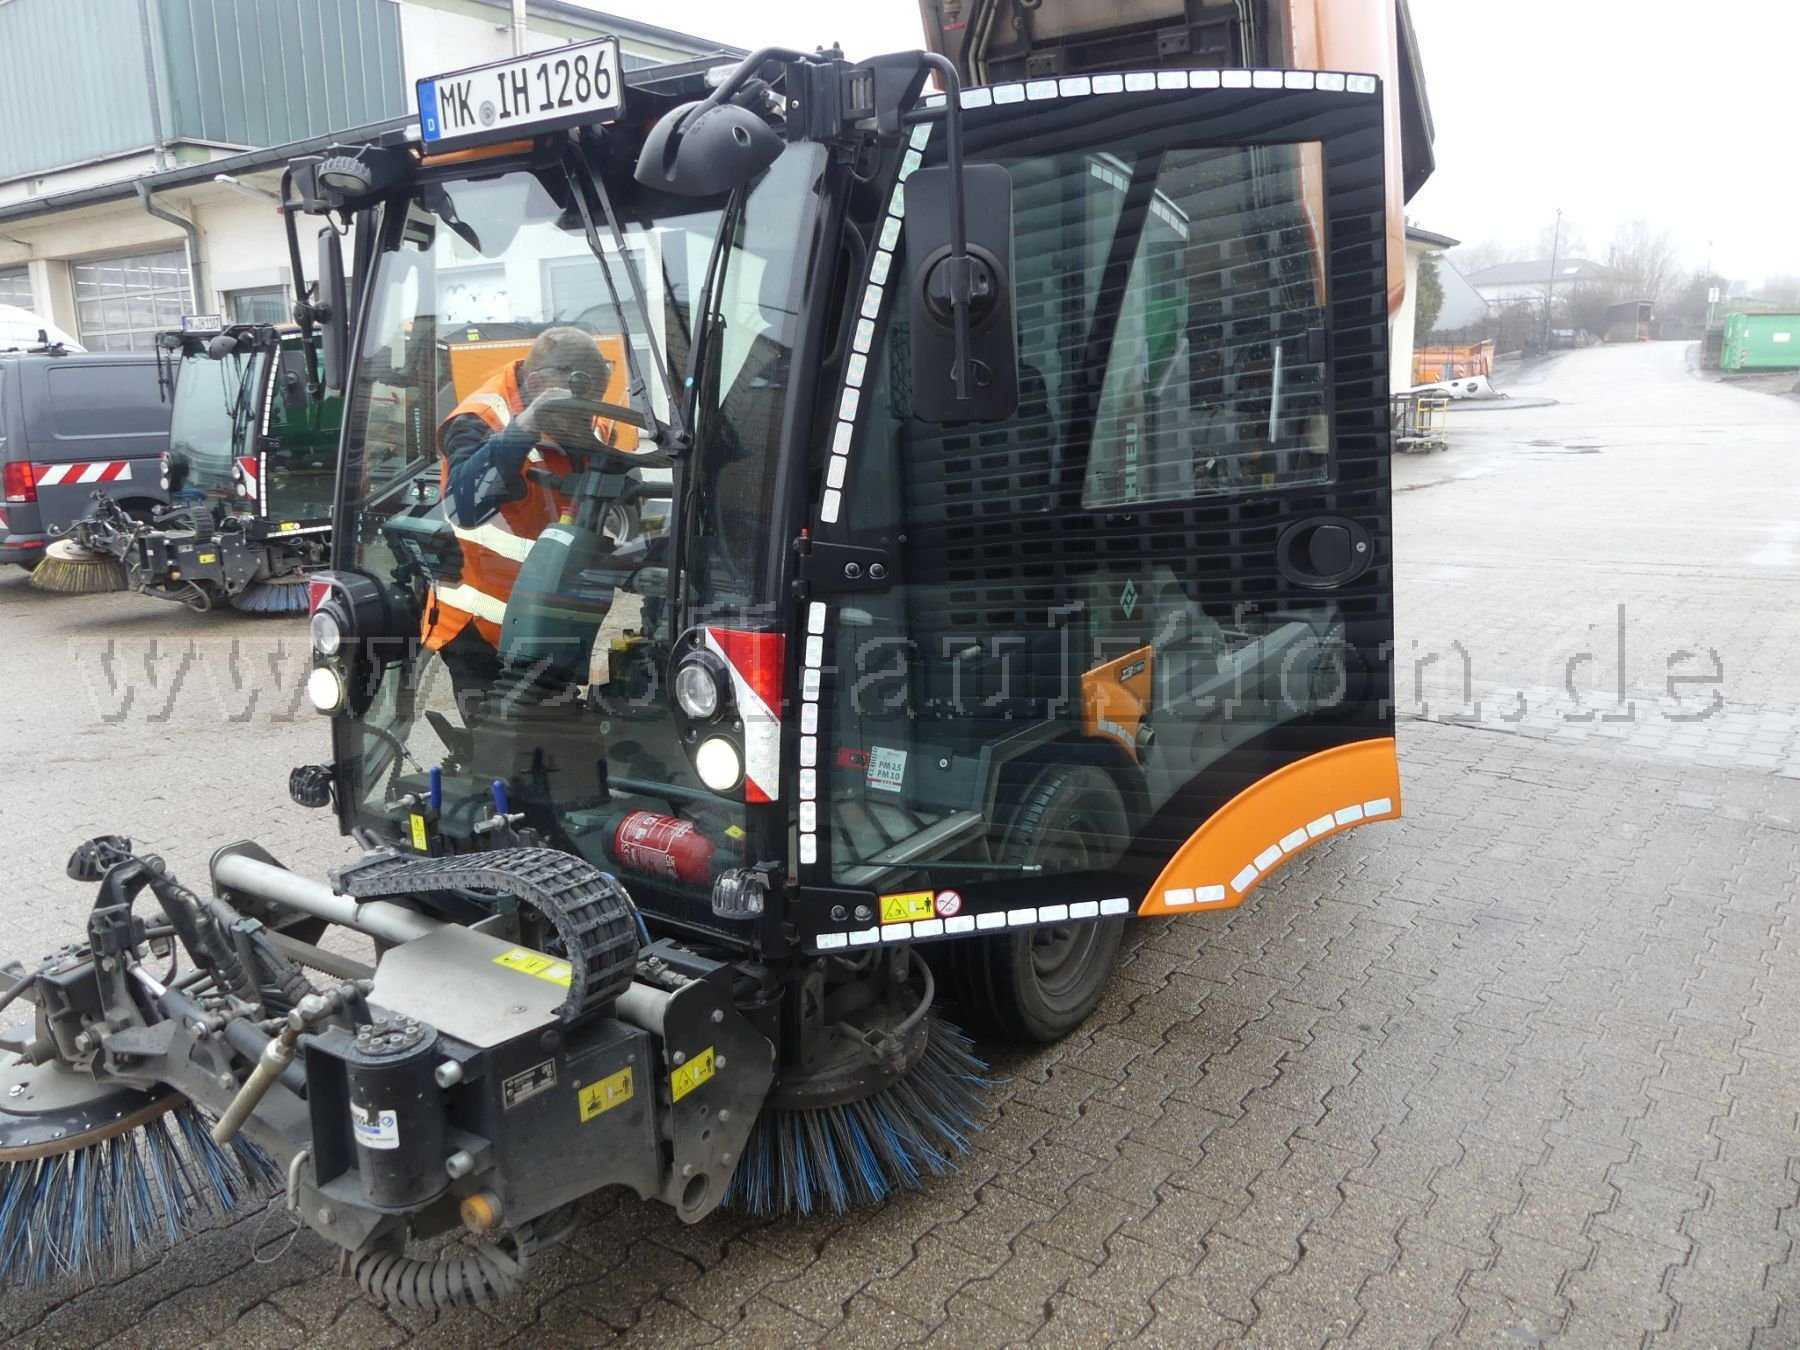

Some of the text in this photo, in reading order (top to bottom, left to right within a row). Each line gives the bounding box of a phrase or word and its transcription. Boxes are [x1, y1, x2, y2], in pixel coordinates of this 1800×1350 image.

[439, 51, 611, 130] MK IH 1286
